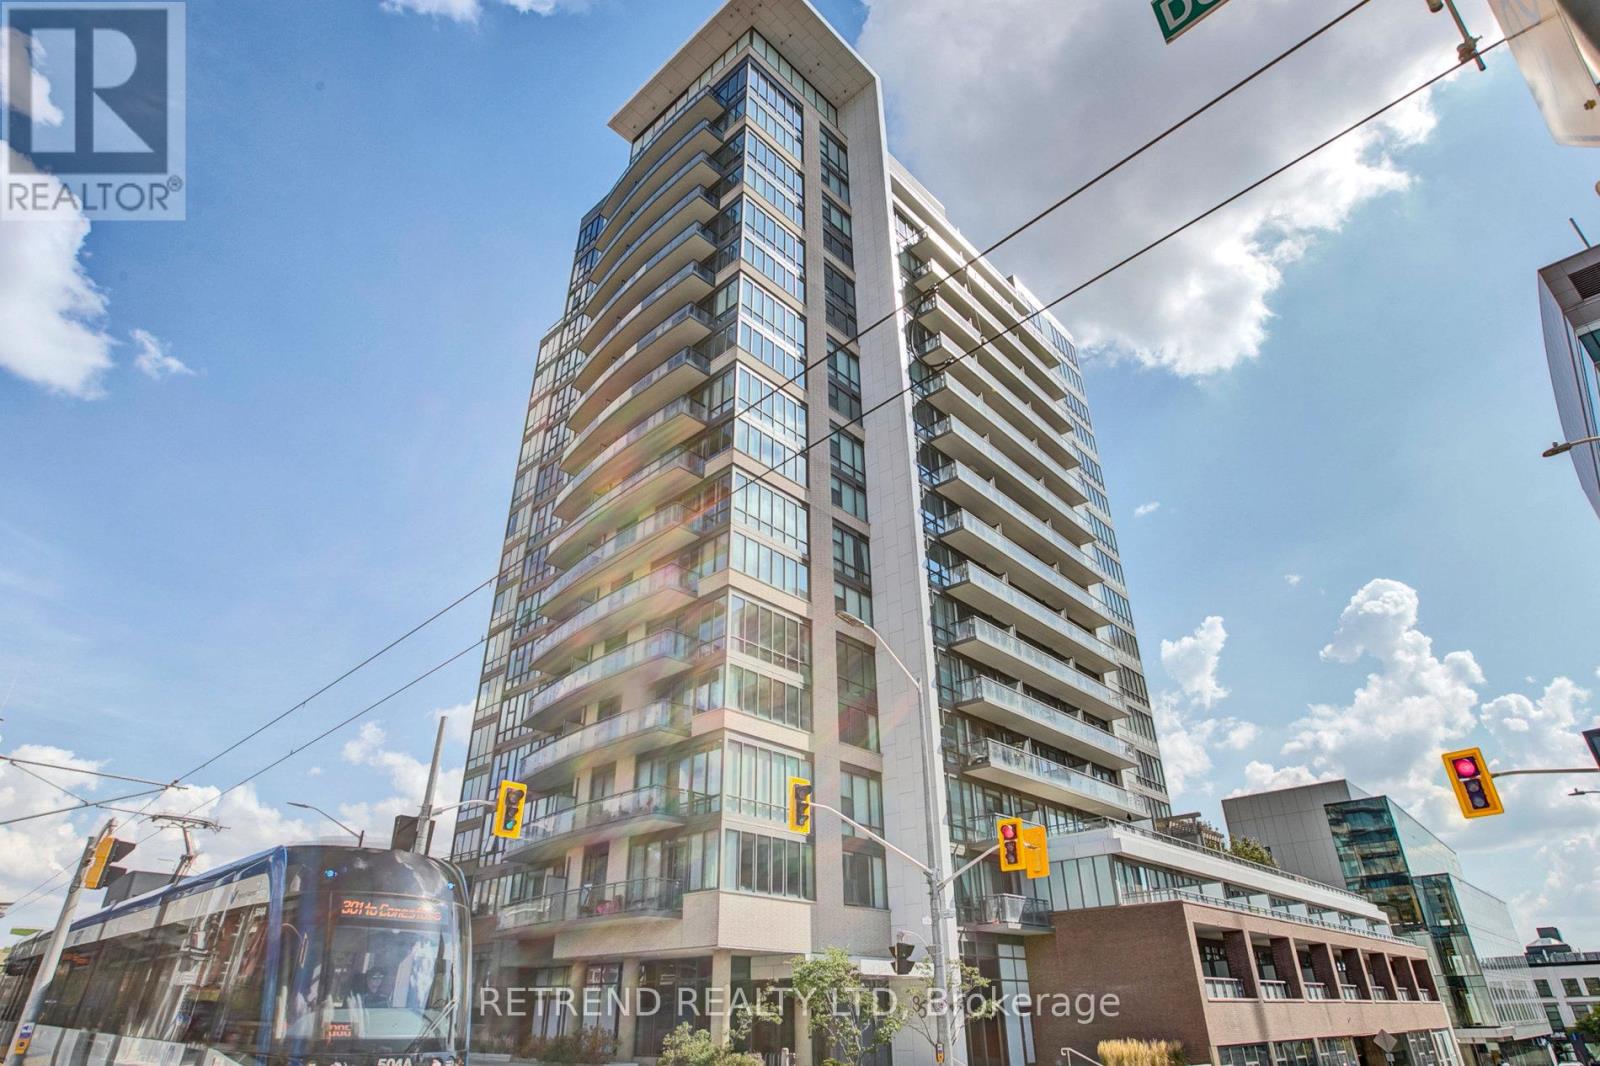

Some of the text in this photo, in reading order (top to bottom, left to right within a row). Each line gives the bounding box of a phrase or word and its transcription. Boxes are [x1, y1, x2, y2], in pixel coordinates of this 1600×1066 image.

[341, 900, 364, 915] 301
[365, 902, 378, 916] to
[912, 995, 928, 1018] 85
